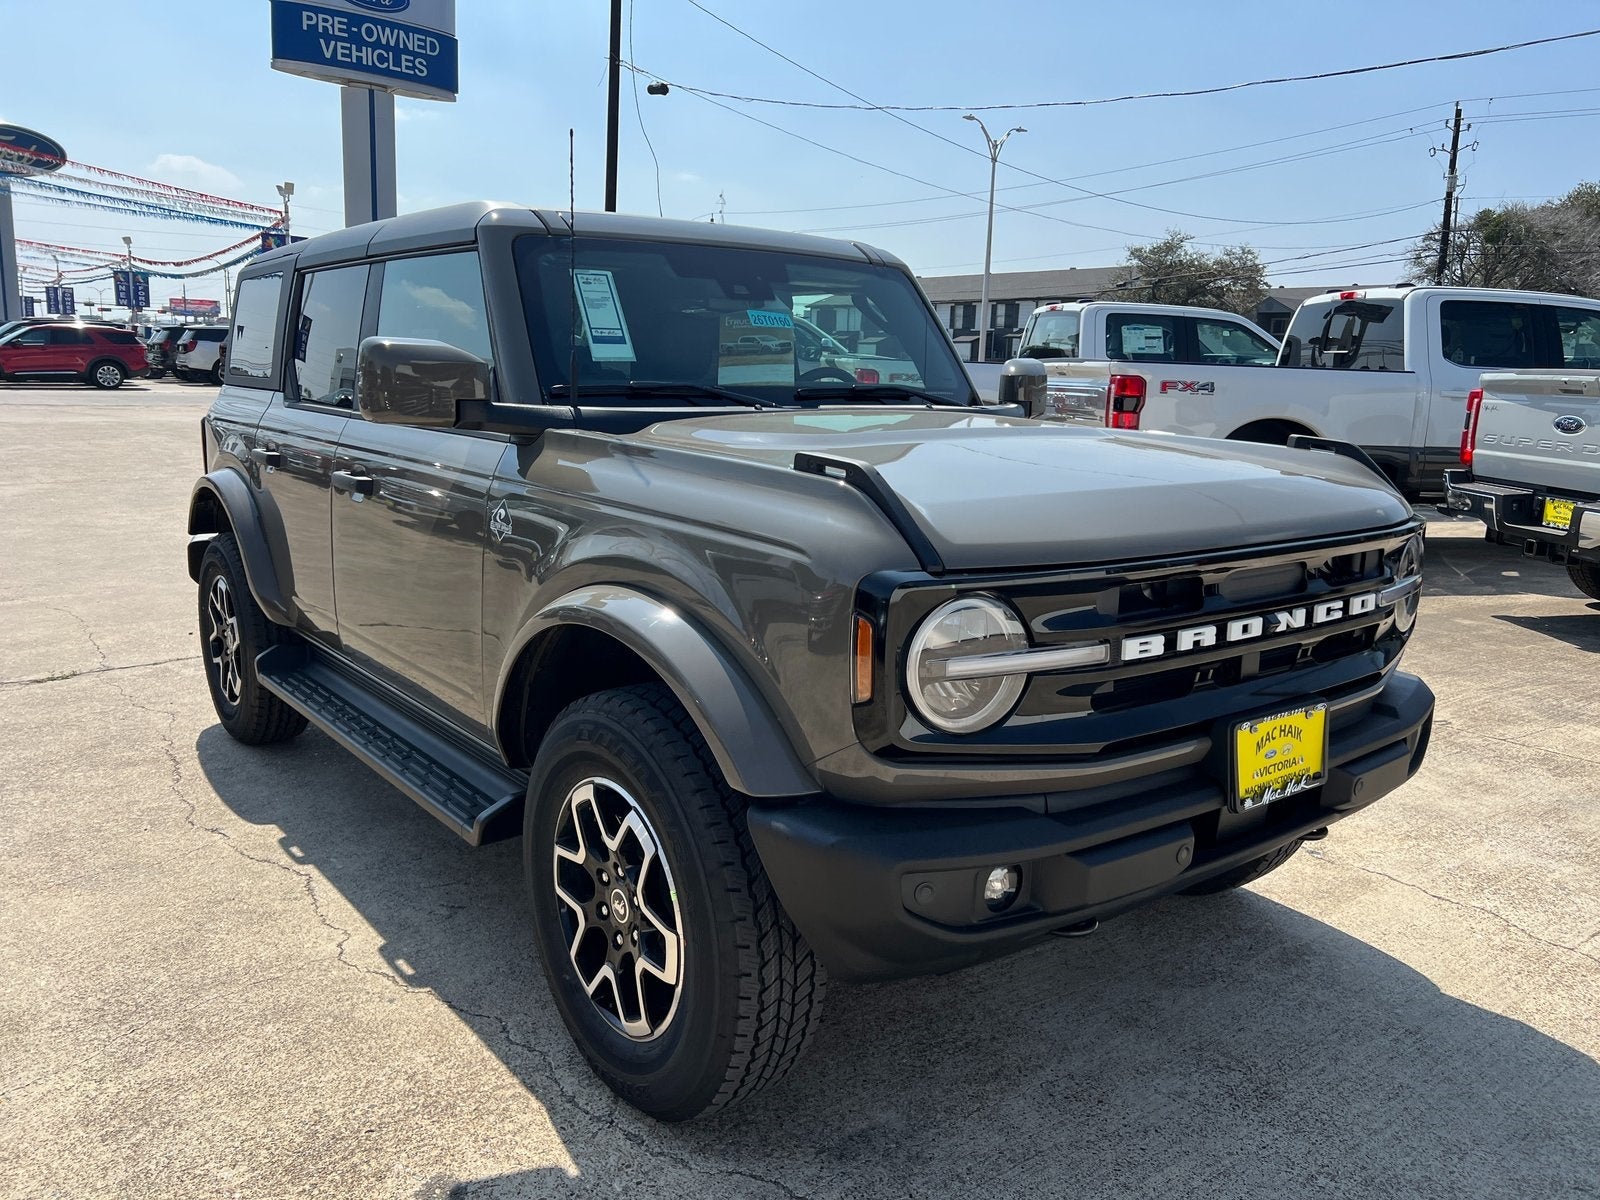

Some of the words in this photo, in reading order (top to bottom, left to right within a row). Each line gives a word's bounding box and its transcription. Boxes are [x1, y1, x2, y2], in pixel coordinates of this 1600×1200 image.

[319, 38, 428, 77] VEHICLES
[118, 285, 128, 305] NEW
[137, 286, 146, 306] FORD
[751, 314, 791, 327] 26T0160
[1160, 380, 1215, 394] FX4
[1483, 433, 1574, 453] SUPER
[1121, 592, 1376, 661] BRONCO
[1255, 726, 1278, 756] MAC
[1279, 723, 1303, 743] HAIK
[1258, 757, 1298, 778] VICTORIA
[1261, 786, 1283, 805] Mac
